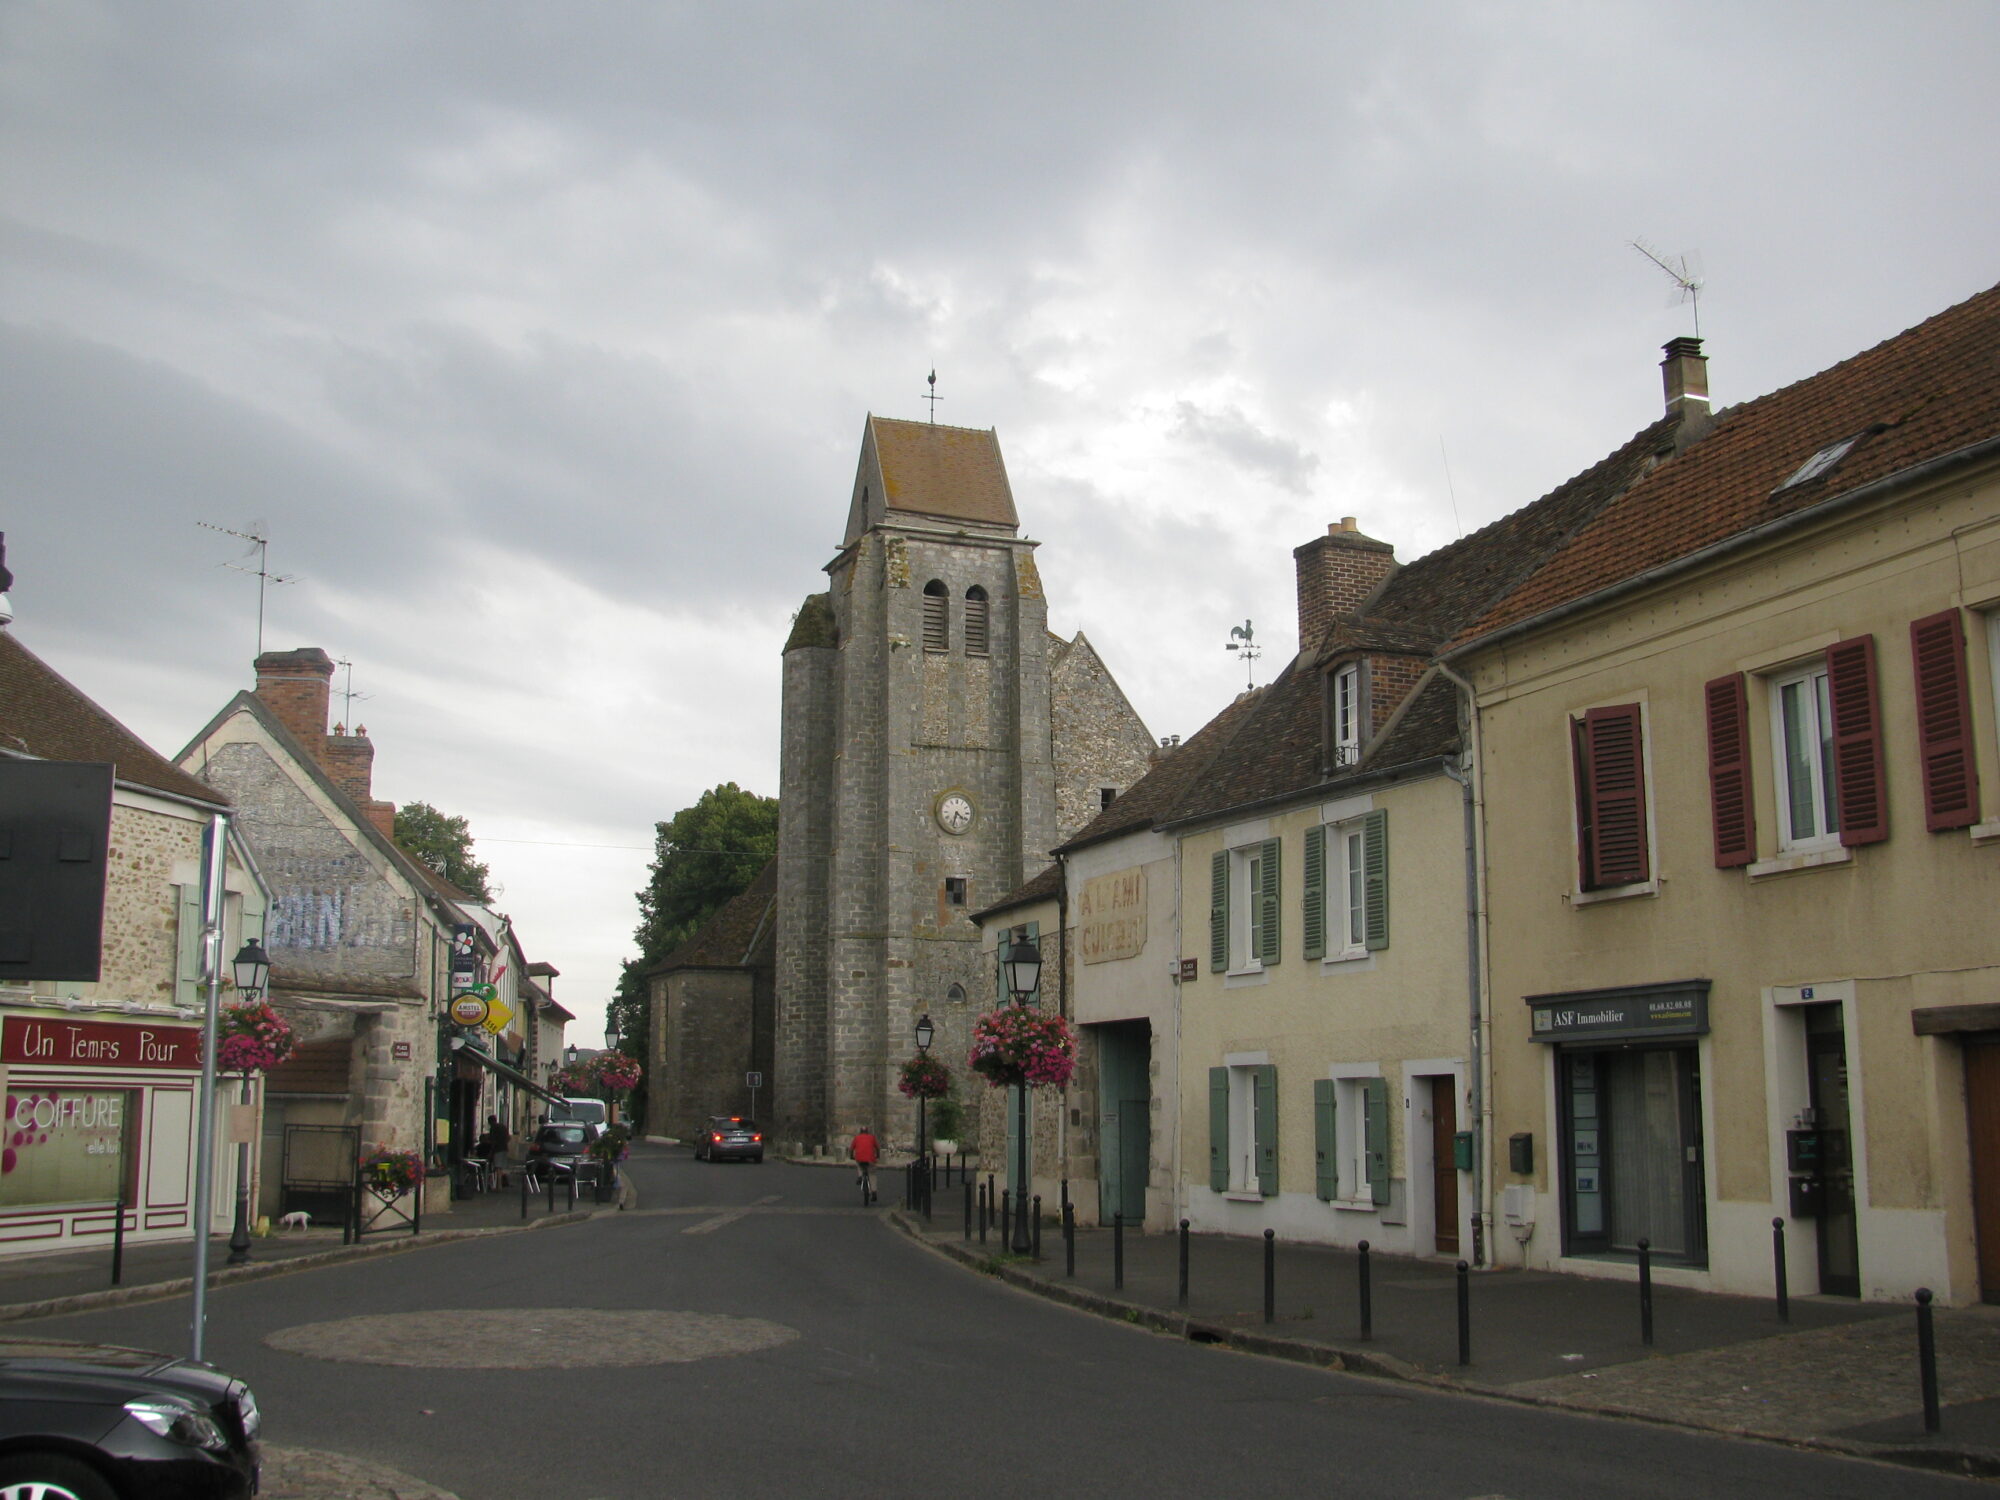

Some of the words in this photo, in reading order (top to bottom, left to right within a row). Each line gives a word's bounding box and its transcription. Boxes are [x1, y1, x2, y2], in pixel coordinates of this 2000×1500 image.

[1553, 1010, 1575, 1027] ASF
[1577, 1010, 1624, 1025] Immobilier
[23, 1024, 54, 1057] Un
[139, 1031, 179, 1062] Pour
[15, 1098, 119, 1128] COIFFURE
